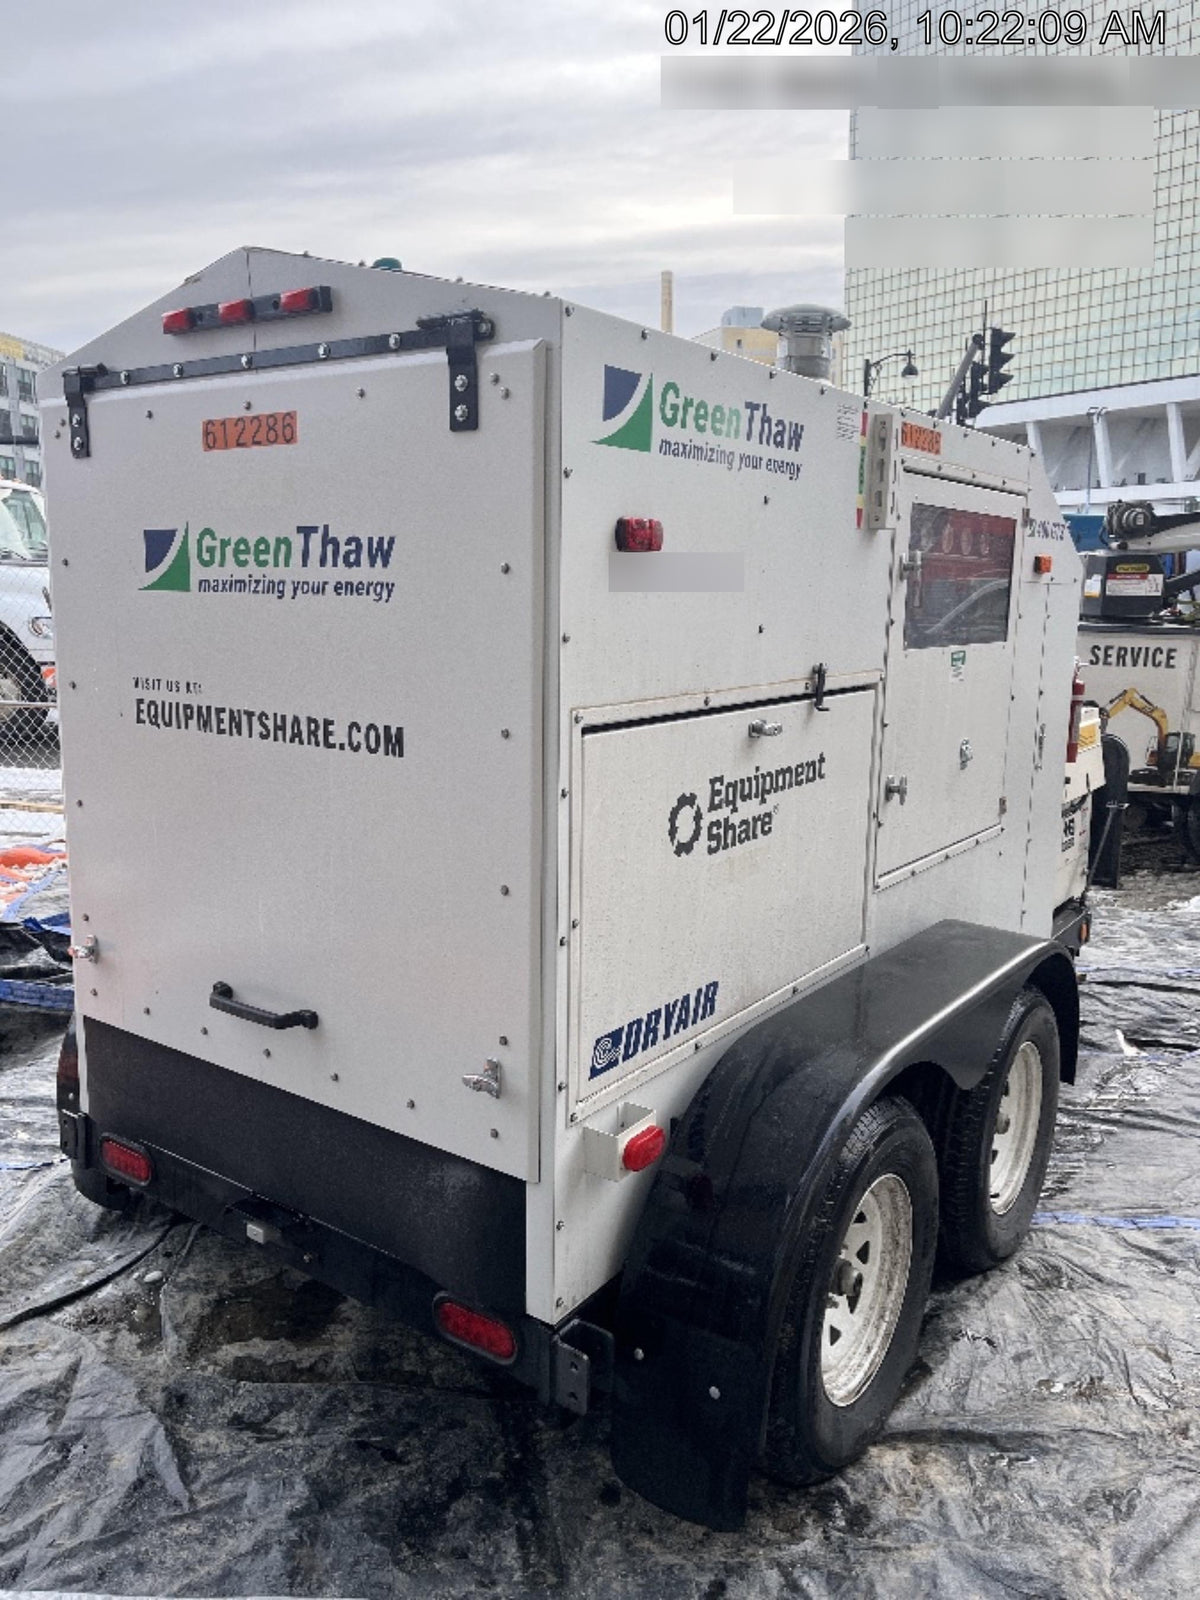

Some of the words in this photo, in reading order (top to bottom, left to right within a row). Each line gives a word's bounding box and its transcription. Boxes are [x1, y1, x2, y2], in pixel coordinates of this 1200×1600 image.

[204, 411, 295, 450] 612286
[658, 438, 735, 471] maximizing
[737, 451, 763, 472] your
[765, 456, 803, 481] energy
[198, 573, 286, 599] maximizing
[291, 579, 329, 599] your
[333, 578, 396, 603] energy
[1089, 644, 1178, 669] SERVICE
[132, 676, 162, 691] VISIT
[166, 680, 181, 693] US
[135, 698, 405, 758] EQUIPMENTSHARE.COM
[707, 752, 826, 814] Equipment
[621, 980, 719, 1063] DRYAIR
